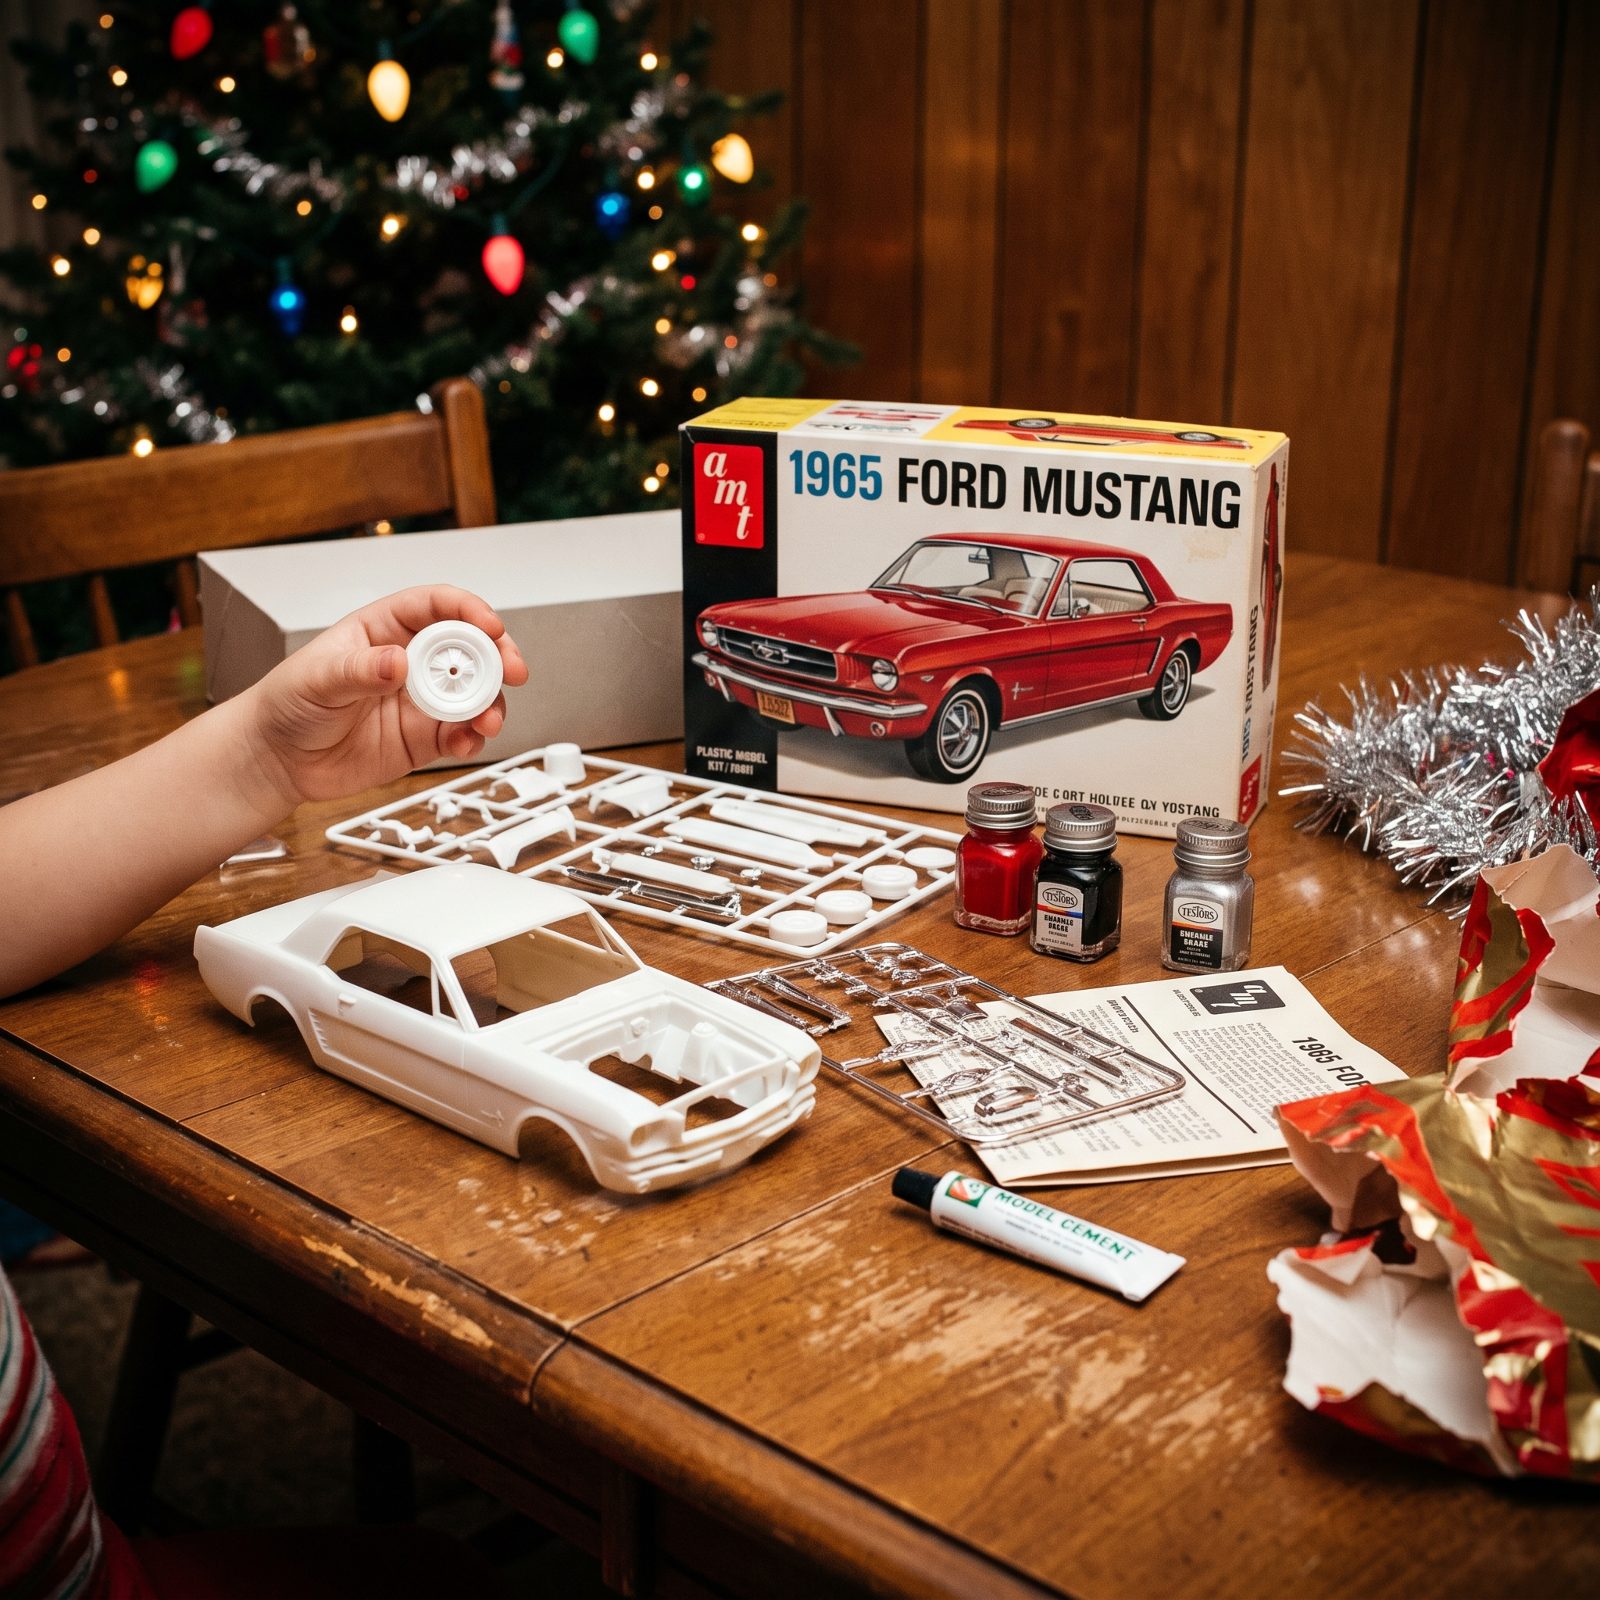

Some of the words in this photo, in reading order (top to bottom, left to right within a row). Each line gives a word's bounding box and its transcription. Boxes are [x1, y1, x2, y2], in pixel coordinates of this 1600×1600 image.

[703, 451, 754, 540] amt
[789, 449, 883, 501] 1965
[898, 457, 1007, 510] FORD
[1022, 466, 1241, 530] MUSTANG
[696, 745, 733, 760] PLASTIC
[708, 760, 724, 772] KIT
[1162, 801, 1220, 818] YOSTANG
[1181, 905, 1215, 920] TESTORS
[994, 1191, 1054, 1223] MODEL
[1060, 1218, 1137, 1262] CEMENT
